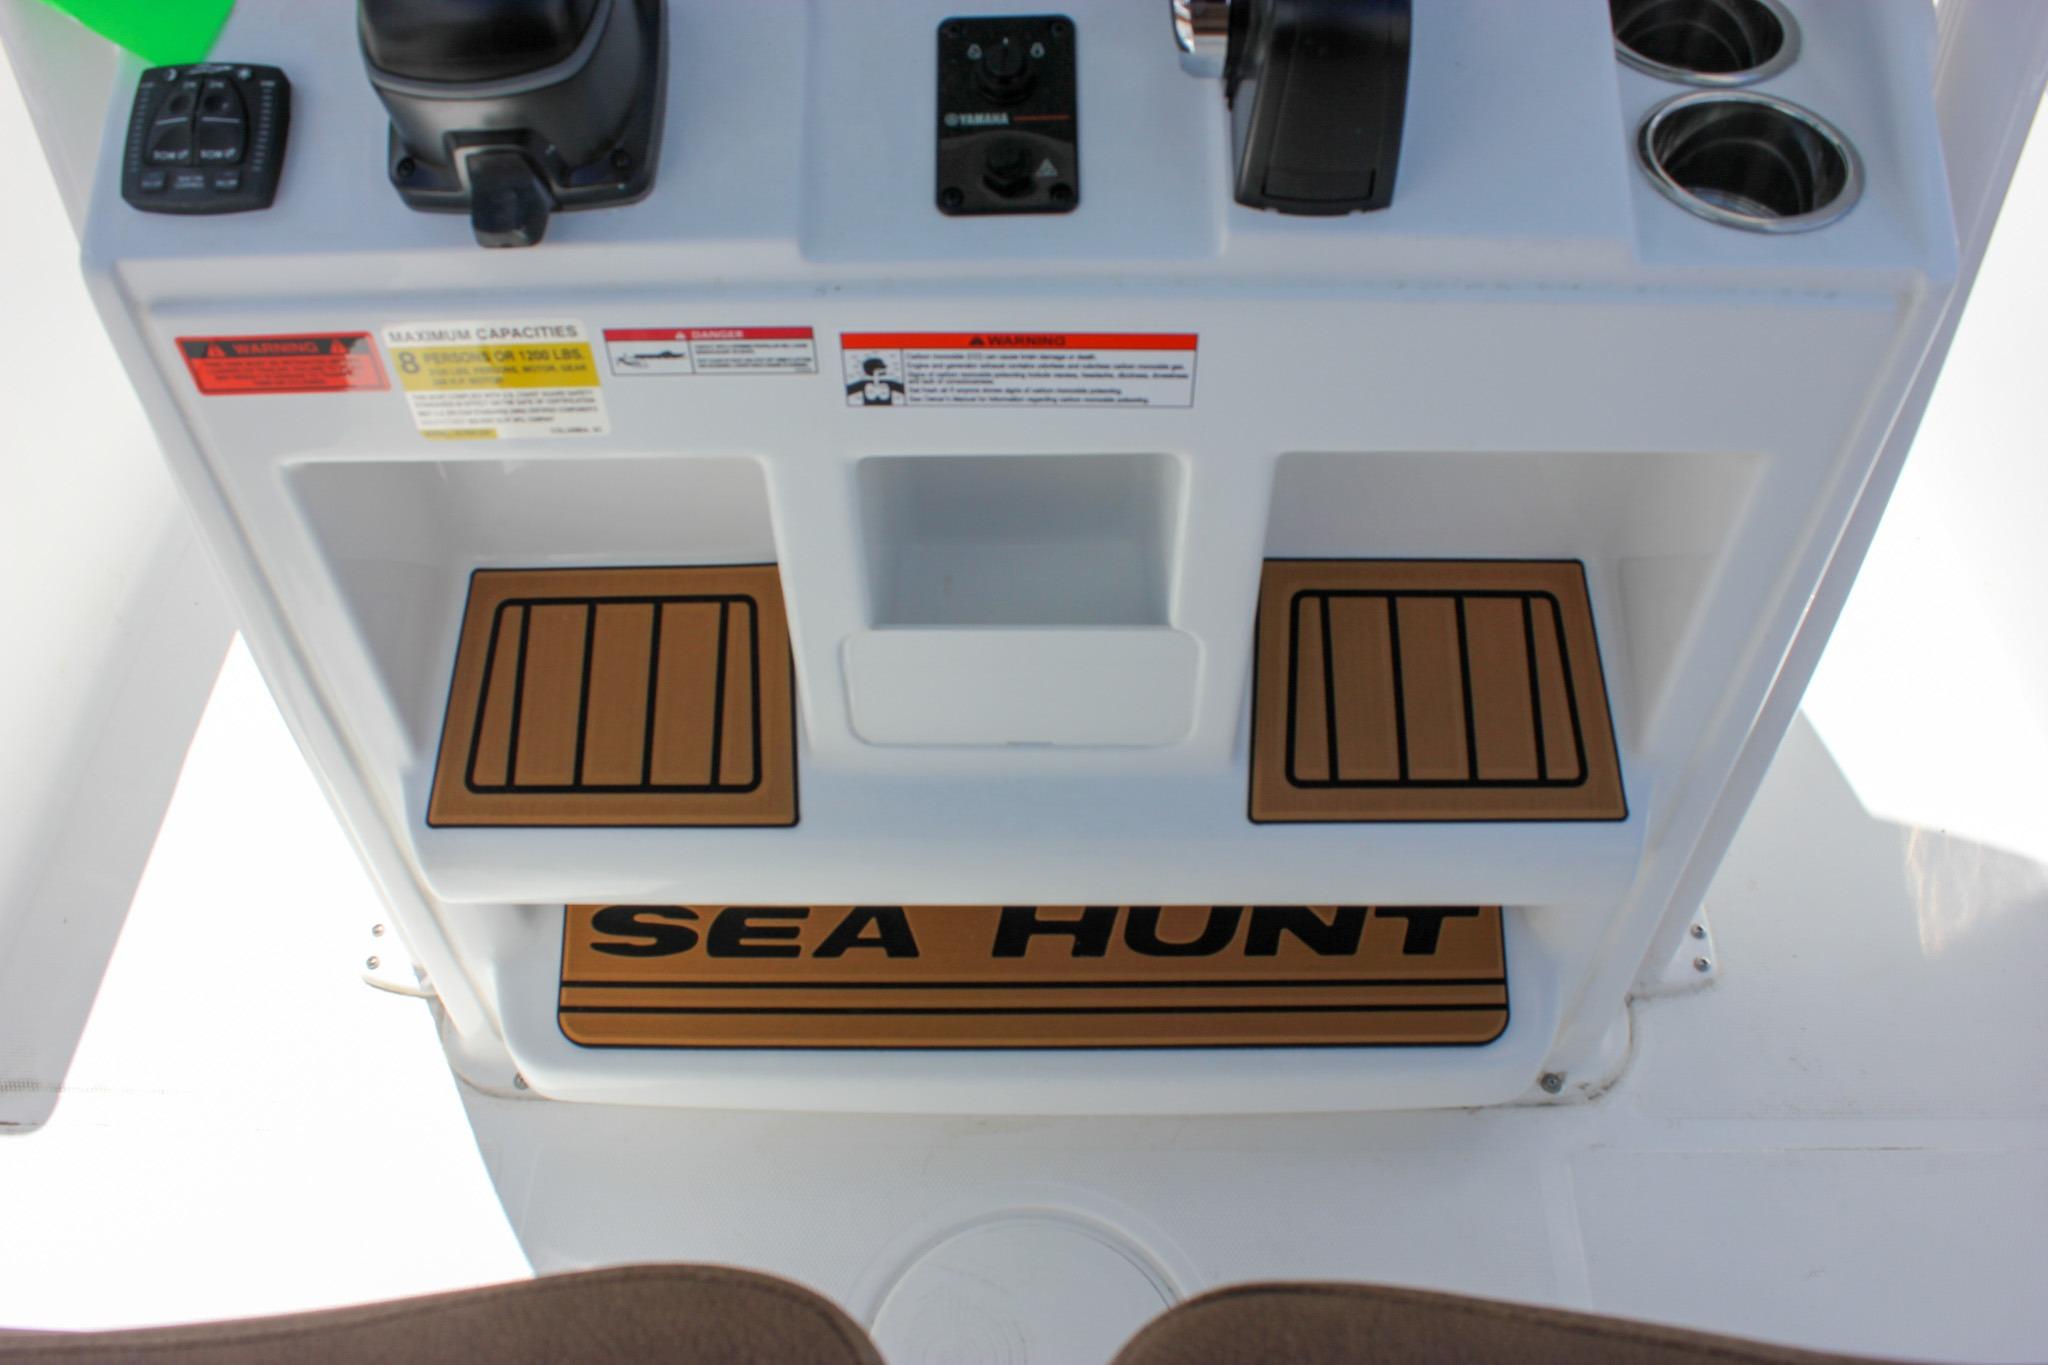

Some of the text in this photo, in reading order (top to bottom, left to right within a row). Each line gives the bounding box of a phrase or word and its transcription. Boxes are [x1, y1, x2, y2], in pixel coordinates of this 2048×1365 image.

[959, 113, 1009, 125] YAMAHA
[388, 324, 578, 342] MAXIMUM CAPACITIES
[989, 335, 1066, 346] WARNING
[398, 351, 420, 374] 8
[590, 905, 1481, 958] SEA HUNT
